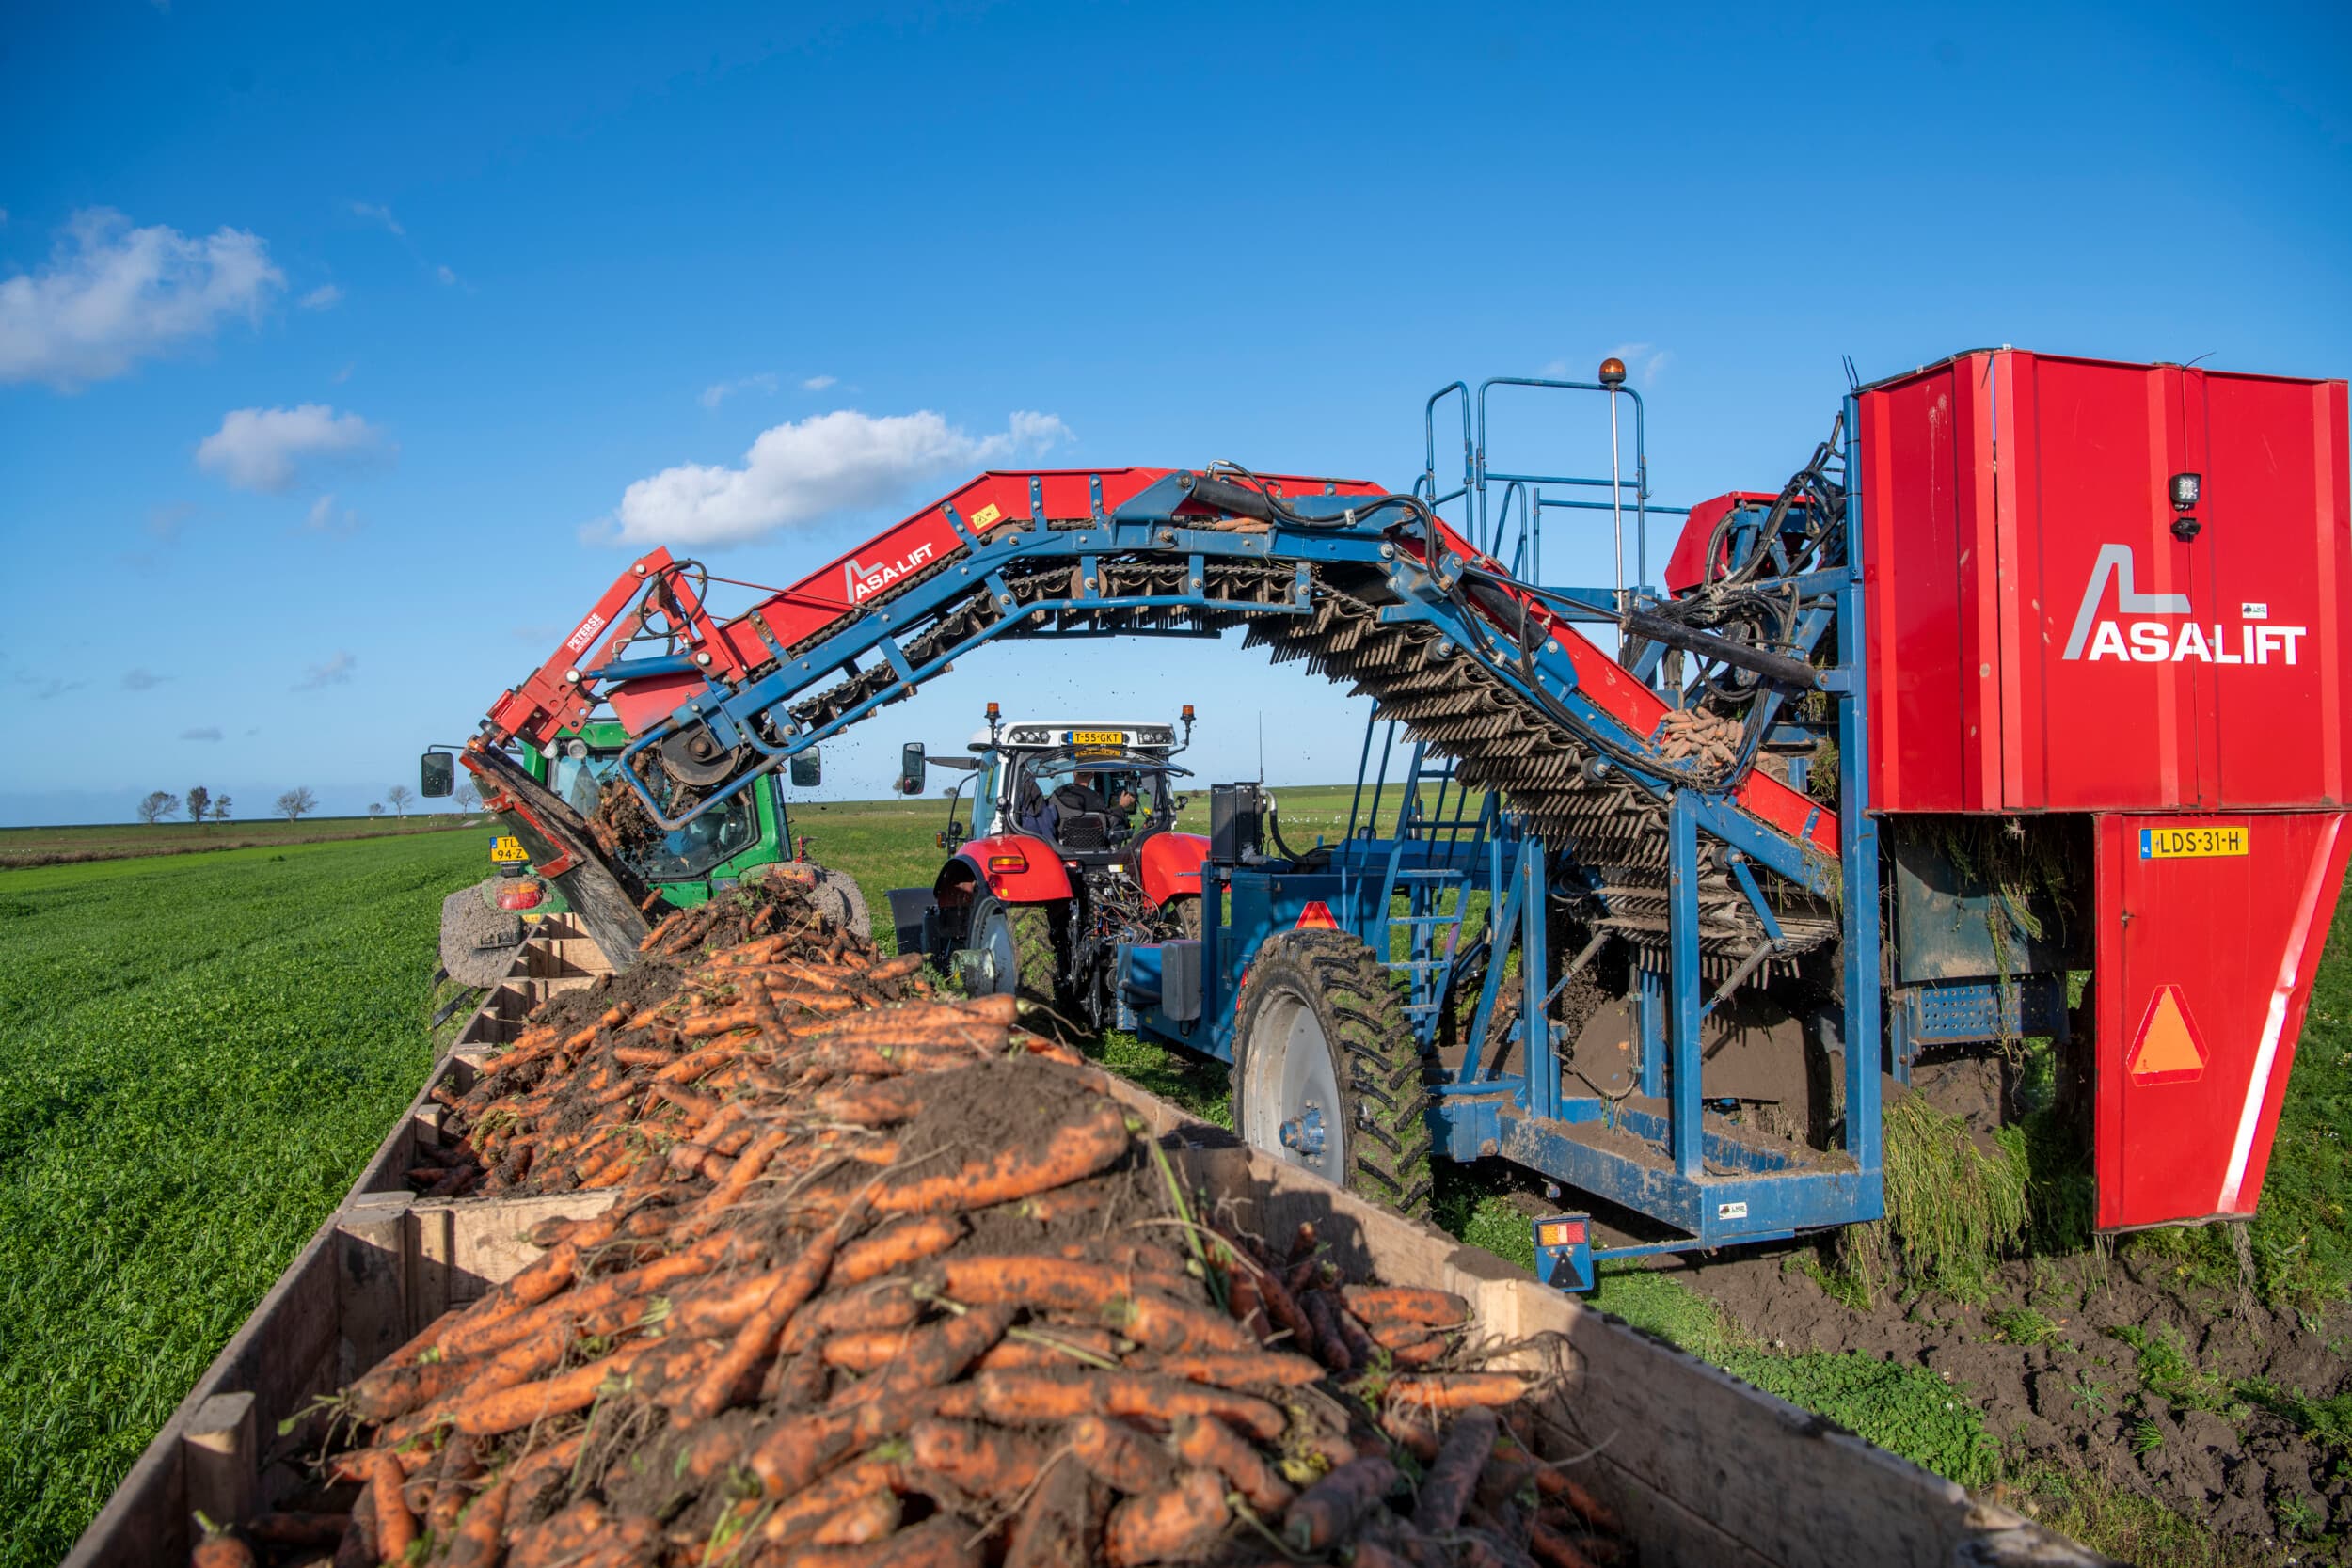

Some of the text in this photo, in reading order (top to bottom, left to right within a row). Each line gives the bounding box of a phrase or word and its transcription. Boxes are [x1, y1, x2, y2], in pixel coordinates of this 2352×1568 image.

[566, 612, 601, 649] PETERSE
[1075, 733, 1119, 743] T-55-GKT
[502, 838, 521, 848] TL
[2160, 831, 2239, 854] LDS-31-H
